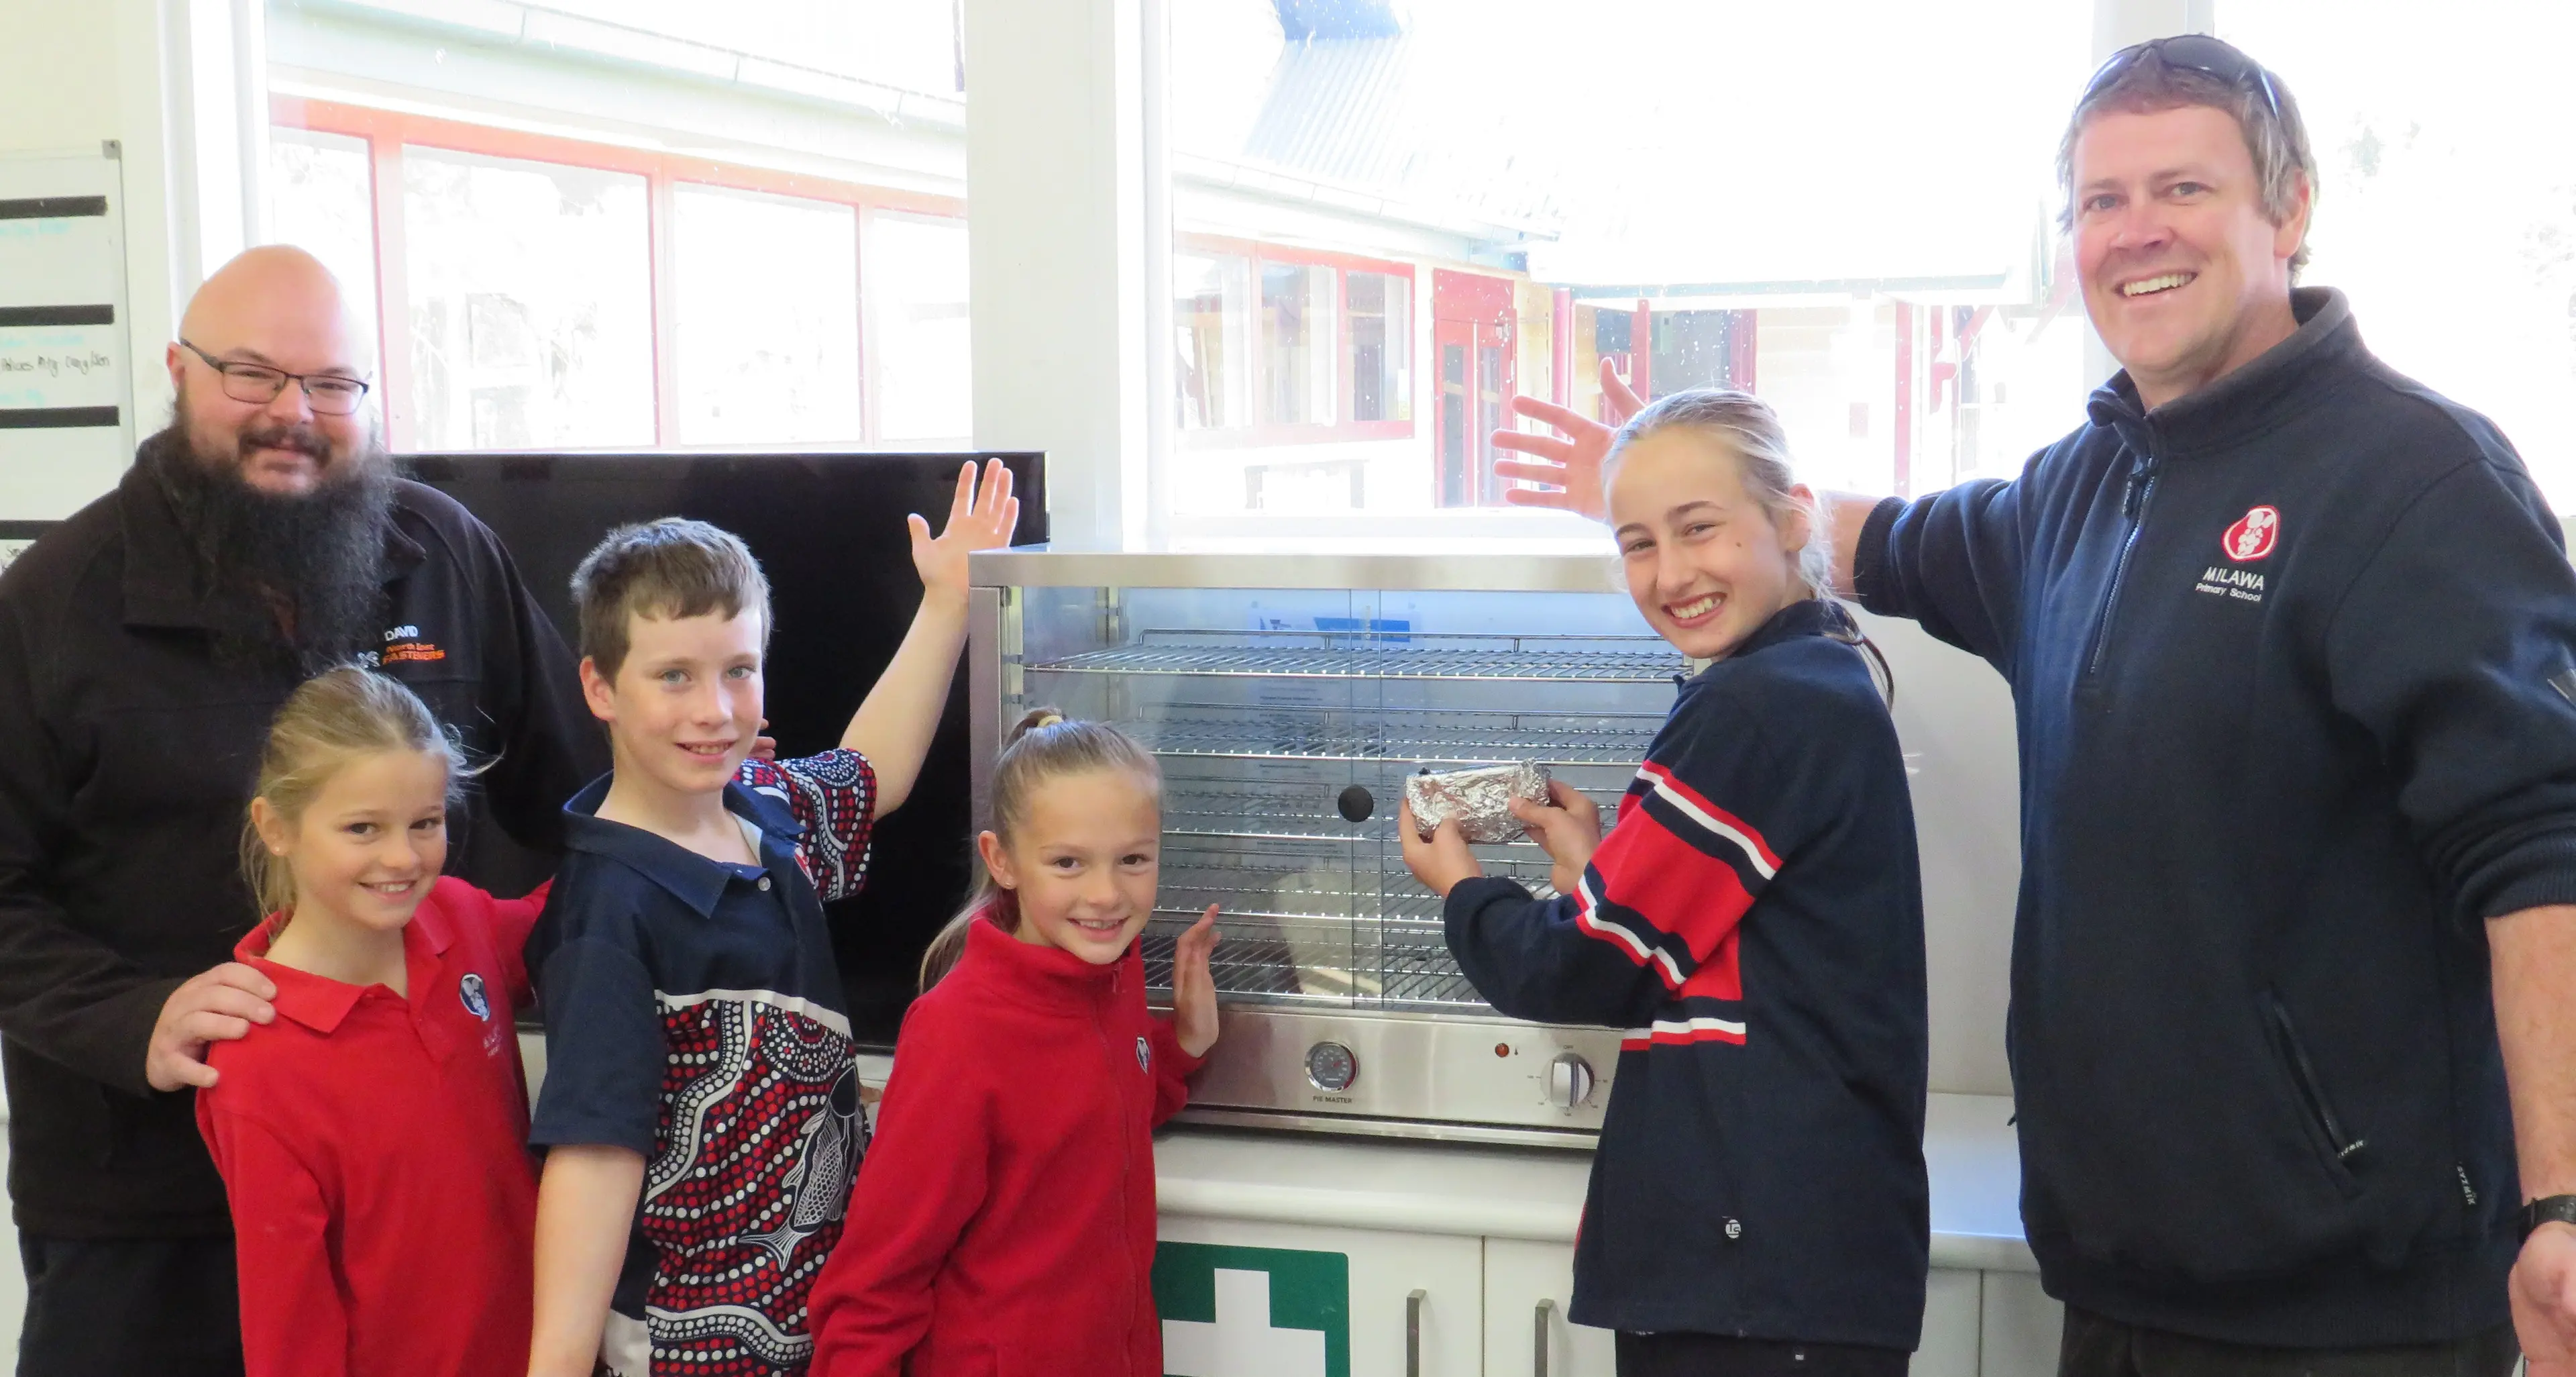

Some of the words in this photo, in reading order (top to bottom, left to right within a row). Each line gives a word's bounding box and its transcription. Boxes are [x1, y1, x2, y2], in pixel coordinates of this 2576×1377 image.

[2202, 566, 2264, 591] MILAWA
[2195, 582, 2227, 596] Primary
[2229, 588, 2262, 603] School
[384, 625, 419, 642] DAVID
